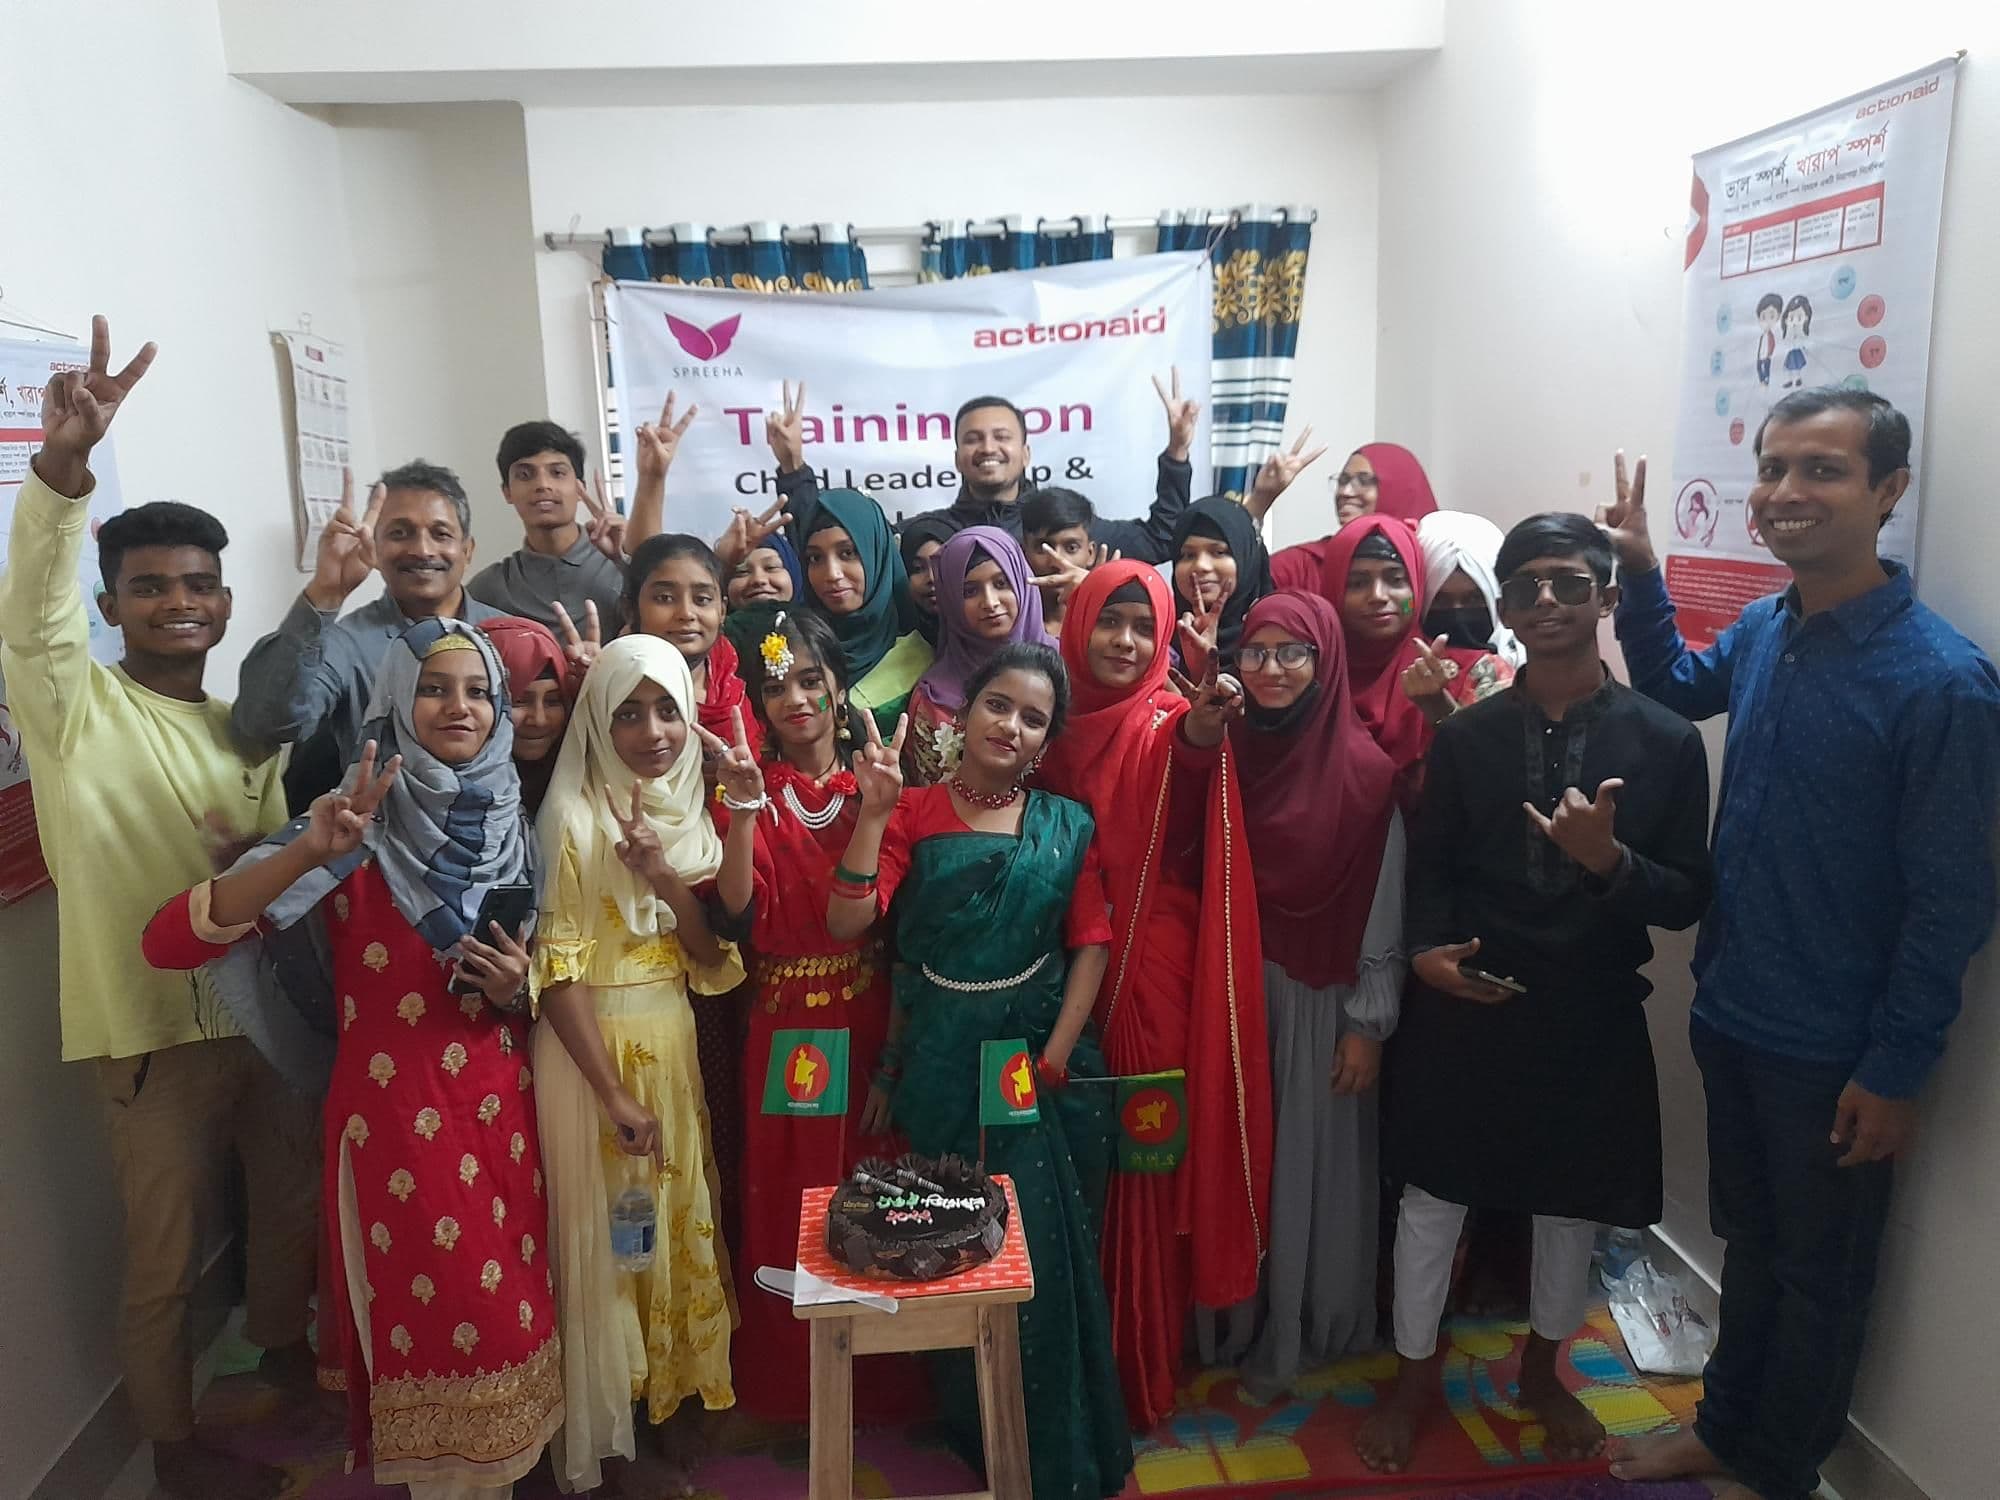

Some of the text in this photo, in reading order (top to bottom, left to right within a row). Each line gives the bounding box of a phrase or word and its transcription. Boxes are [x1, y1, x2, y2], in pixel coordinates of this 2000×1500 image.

[672, 367, 743, 378] SPREEHA
[723, 402, 1094, 446] Tainin on
[1065, 457, 1094, 480] &
